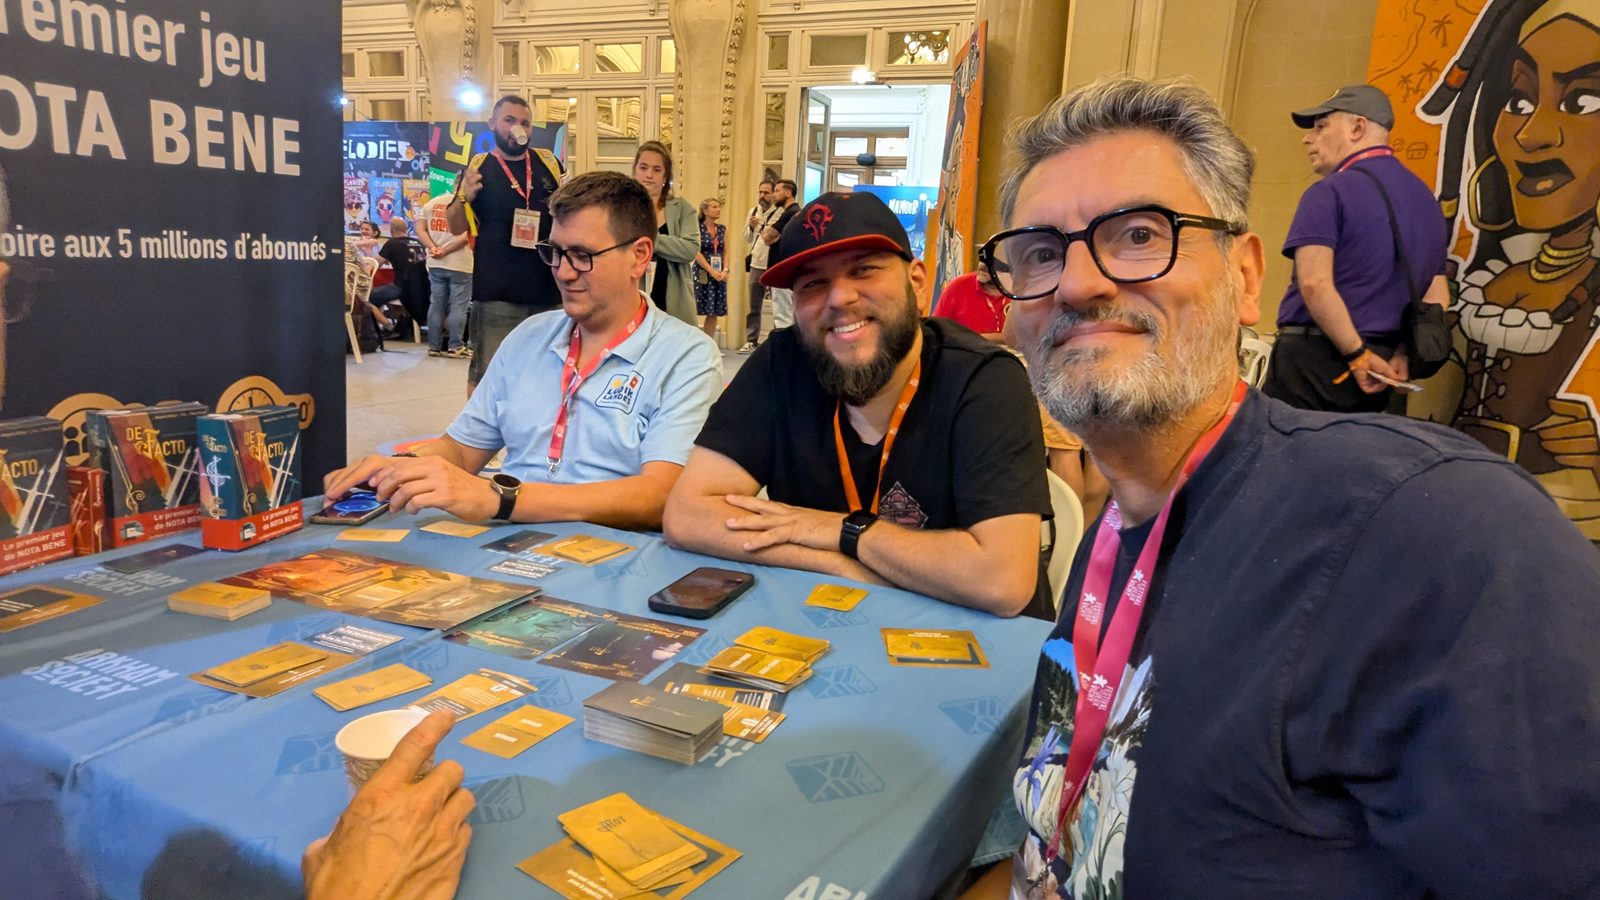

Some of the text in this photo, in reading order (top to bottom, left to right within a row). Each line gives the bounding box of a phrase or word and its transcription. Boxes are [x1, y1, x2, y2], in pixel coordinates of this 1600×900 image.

[199, 11, 266, 88] jeu
[0, 74, 300, 176] OTA BENE
[0, 224, 56, 258] oire
[64, 234, 113, 258] aux
[118, 228, 132, 259] 5
[140, 230, 228, 260] millions
[126, 427, 142, 441] DE
[244, 430, 254, 445] DE
[16, 534, 50, 549] premier
[51, 530, 65, 540] jeu
[16, 545, 41, 558] NOTA
[42, 539, 67, 552] BENE
